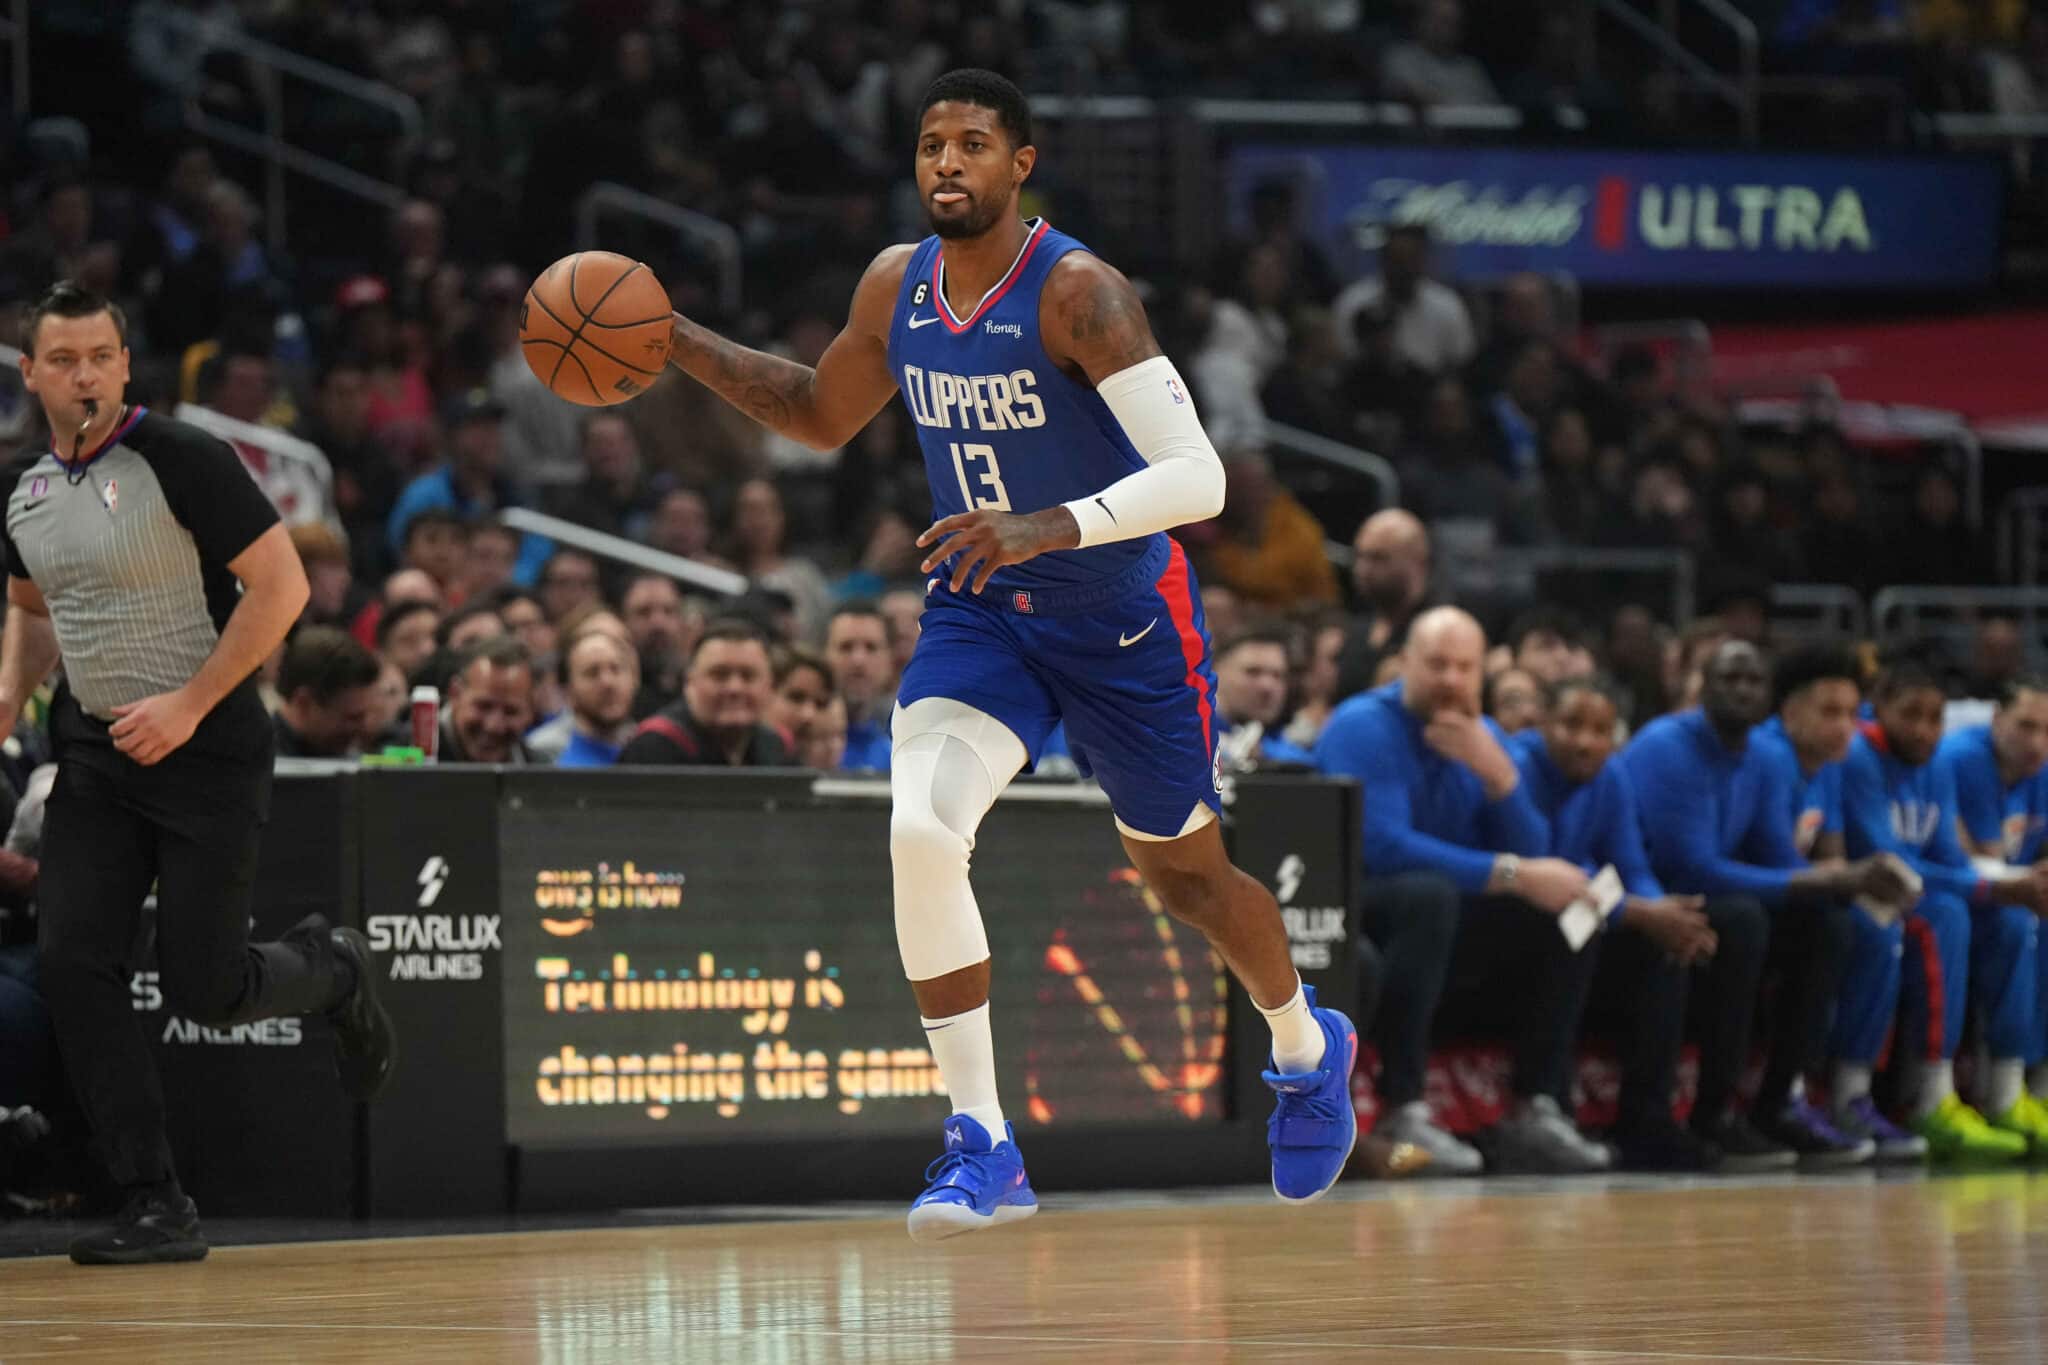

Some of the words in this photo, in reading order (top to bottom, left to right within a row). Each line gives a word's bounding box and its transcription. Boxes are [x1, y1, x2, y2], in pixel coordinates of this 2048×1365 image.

[1639, 184, 1874, 252] ULTRA
[914, 284, 927, 304] 6
[984, 320, 1023, 338] honey
[904, 364, 1046, 430] CLIPPERS
[949, 443, 1012, 512] 13
[367, 914, 502, 951] STARLUX
[1281, 906, 1347, 942] RLUX
[389, 954, 483, 981] AIRLINES
[535, 953, 795, 1035] Technology
[805, 950, 845, 1010] is
[536, 1043, 744, 1119] changing
[754, 1040, 829, 1099] the
